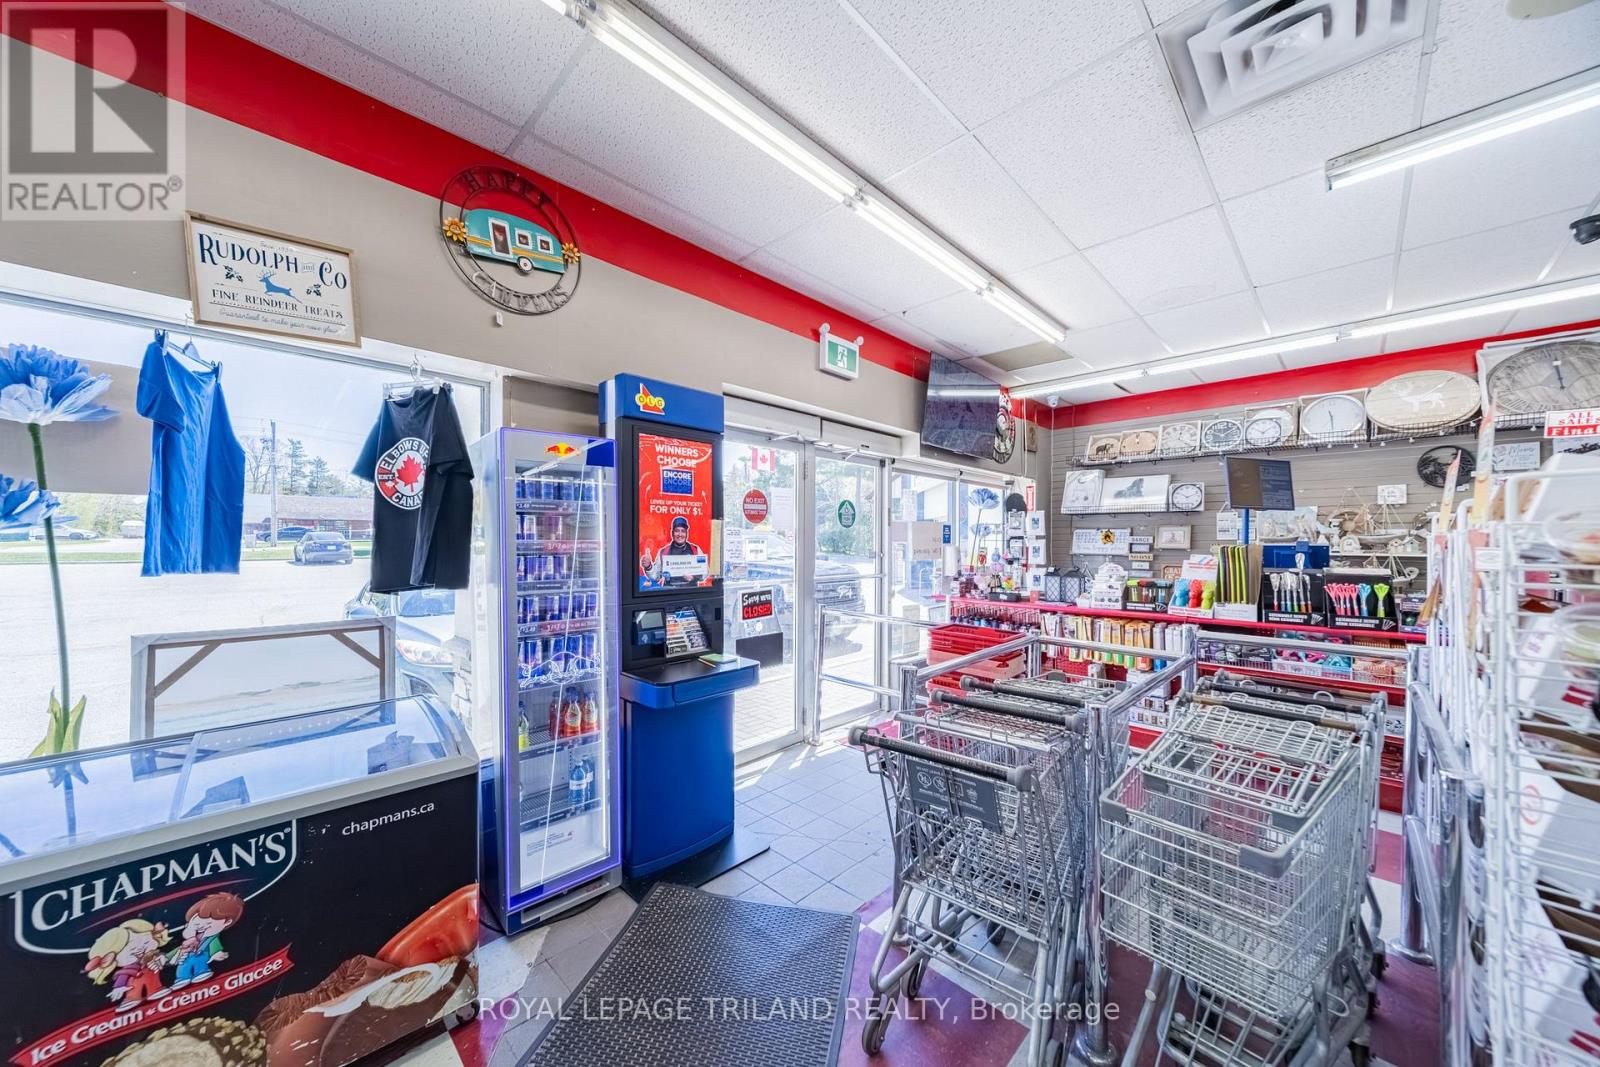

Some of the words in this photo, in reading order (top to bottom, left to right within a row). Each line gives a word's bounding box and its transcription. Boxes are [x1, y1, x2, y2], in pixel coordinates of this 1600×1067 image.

[460, 169, 552, 206] HAPPY
[198, 233, 298, 273] RUDOLPH
[212, 289, 238, 301] FINE
[245, 294, 298, 311] REINDEER
[304, 305, 343, 319] TREATS
[472, 271, 569, 312] CAMPERS
[380, 440, 419, 471] ELBOWS
[655, 443, 699, 457] WINNERS
[656, 455, 697, 468] CHOOSE
[663, 471, 692, 480] ENCORE
[392, 491, 424, 507] CANA
[650, 505, 668, 513] FOR
[670, 506, 691, 515] ONLY
[743, 603, 772, 618] CLOSED
[342, 802, 435, 836] chapmans.ca
[30, 1038, 67, 1066] Ice
[70, 1009, 143, 1044] Cream
[157, 984, 220, 1013] Crème
[224, 958, 283, 990] Glacée
